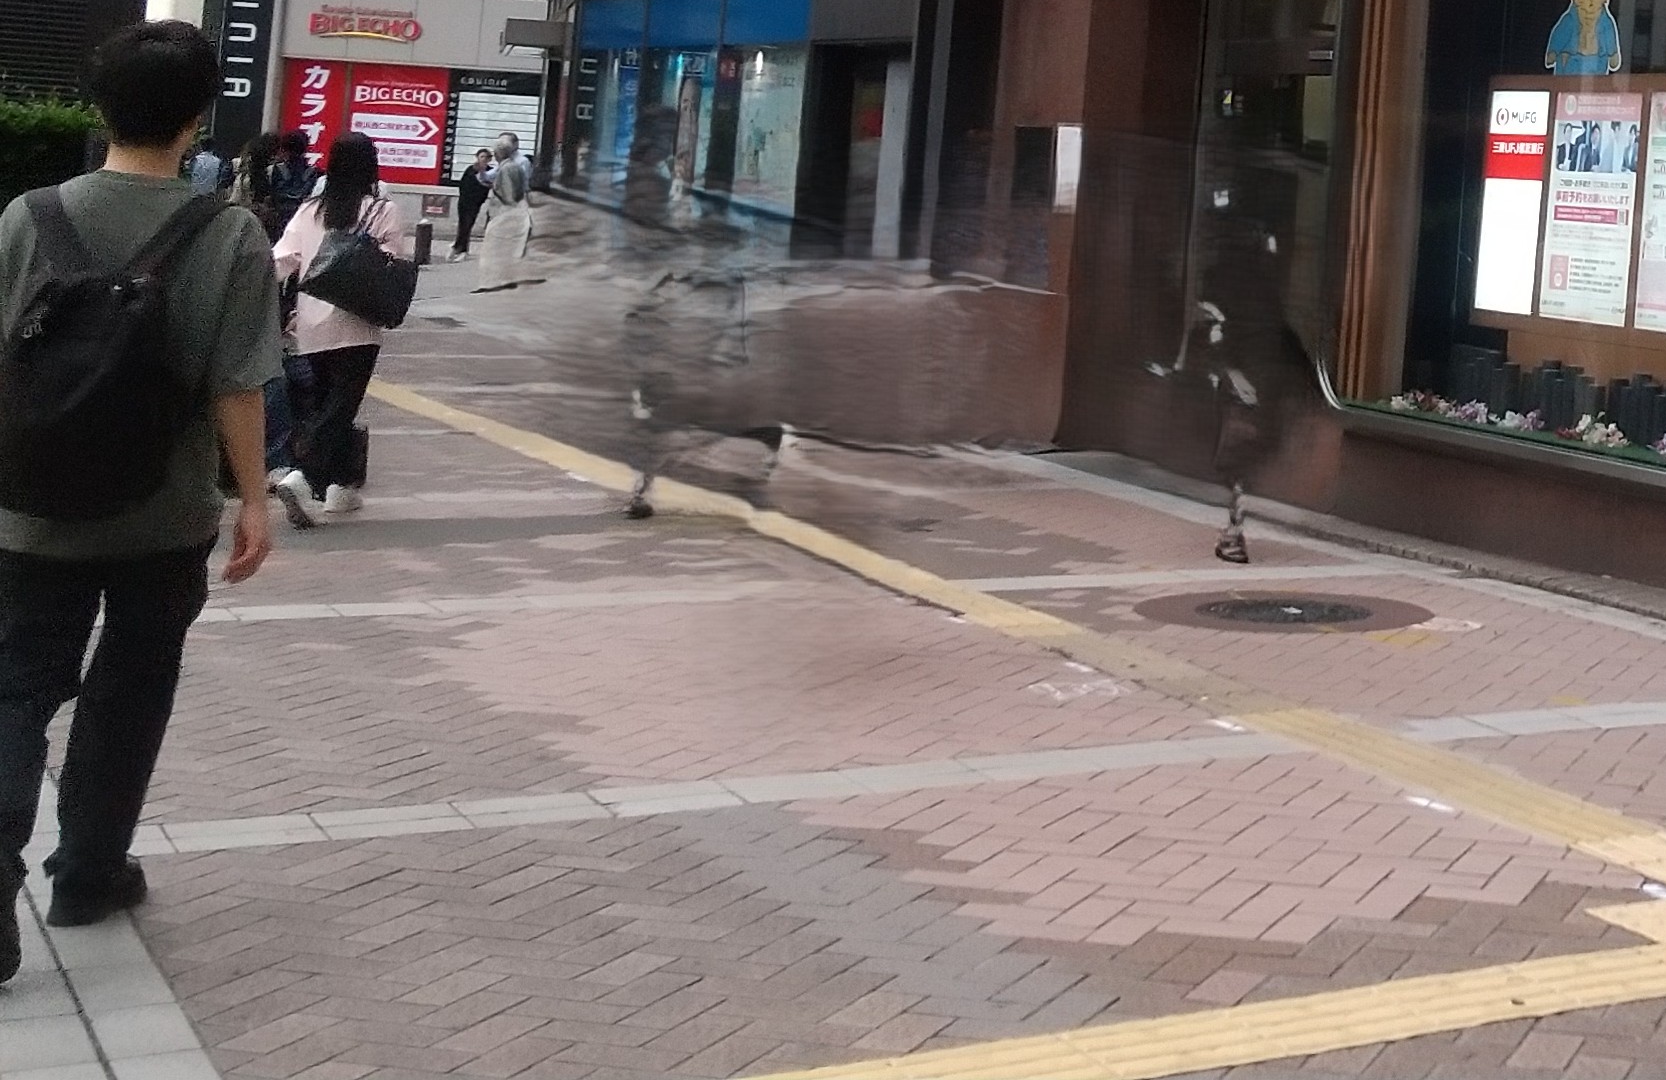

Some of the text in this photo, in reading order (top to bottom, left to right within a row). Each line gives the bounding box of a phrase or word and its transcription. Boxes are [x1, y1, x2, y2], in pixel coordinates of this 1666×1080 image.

[309, 12, 423, 42] BIG ECHO
[354, 84, 390, 103] BIG
[393, 88, 445, 108] ECHO
[1511, 111, 1537, 124] MUFG
